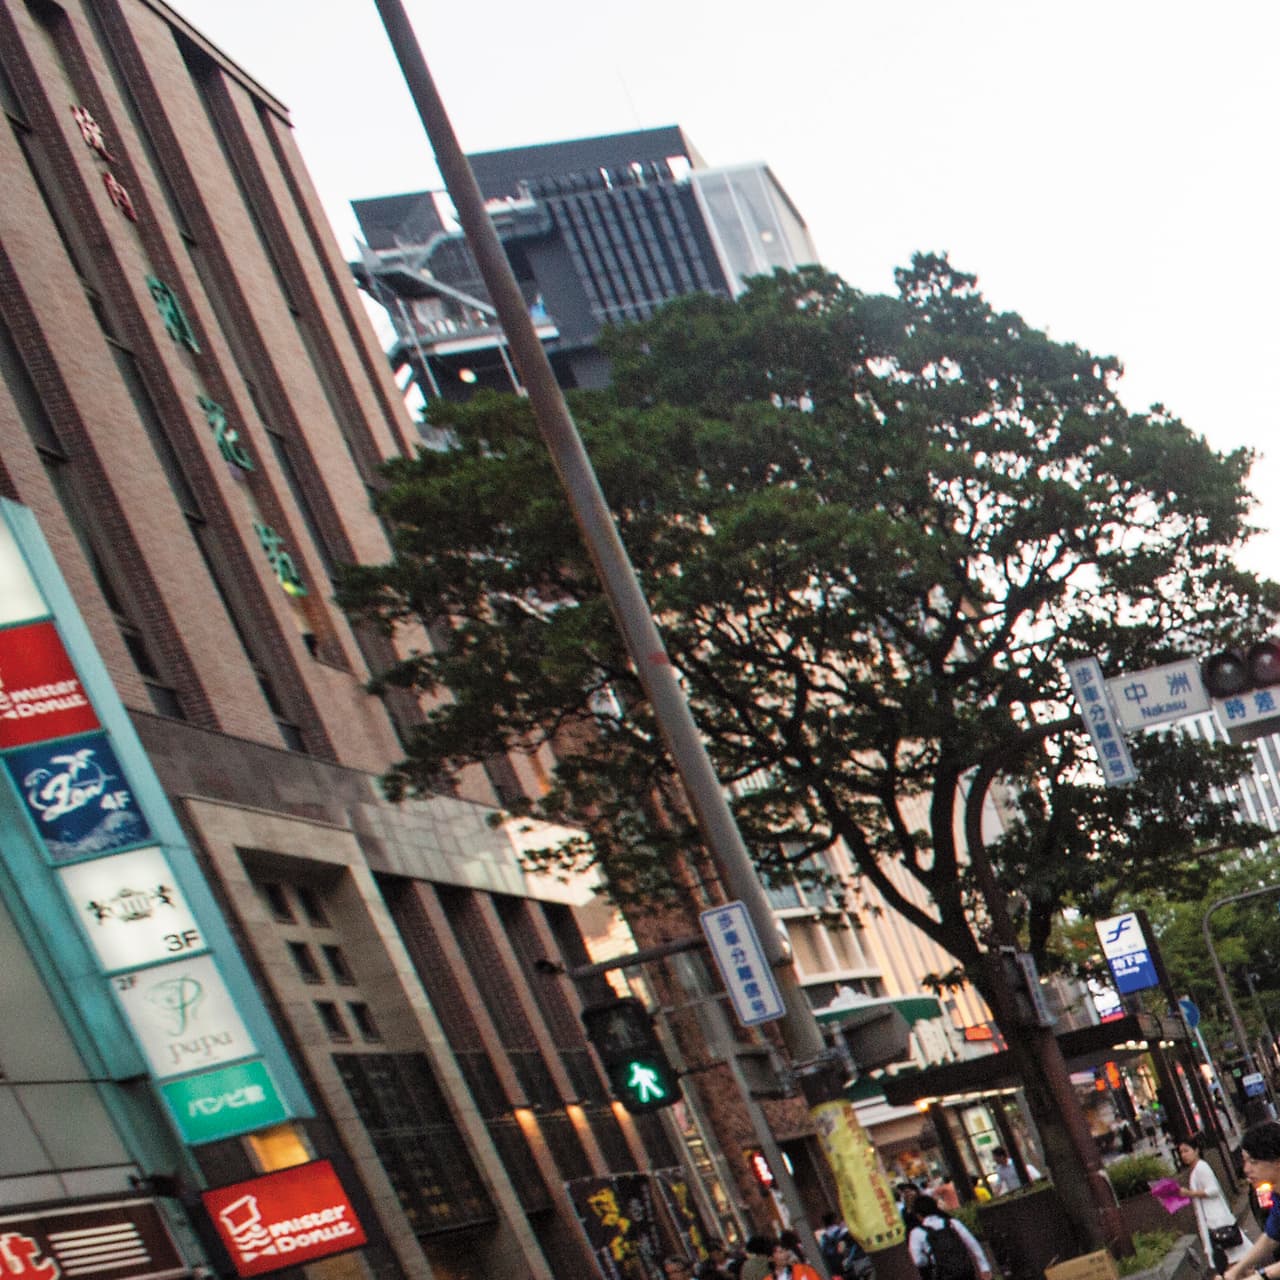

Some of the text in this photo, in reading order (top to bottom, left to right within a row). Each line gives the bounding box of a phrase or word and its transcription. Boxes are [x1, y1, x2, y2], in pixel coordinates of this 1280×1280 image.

[1124, 671, 1192, 704] 中洲
[1141, 699, 1188, 719] Nakasu
[1075, 668, 1126, 777] 歩車分離信号
[100, 791, 130, 810] 4F
[164, 929, 199, 952] 3F
